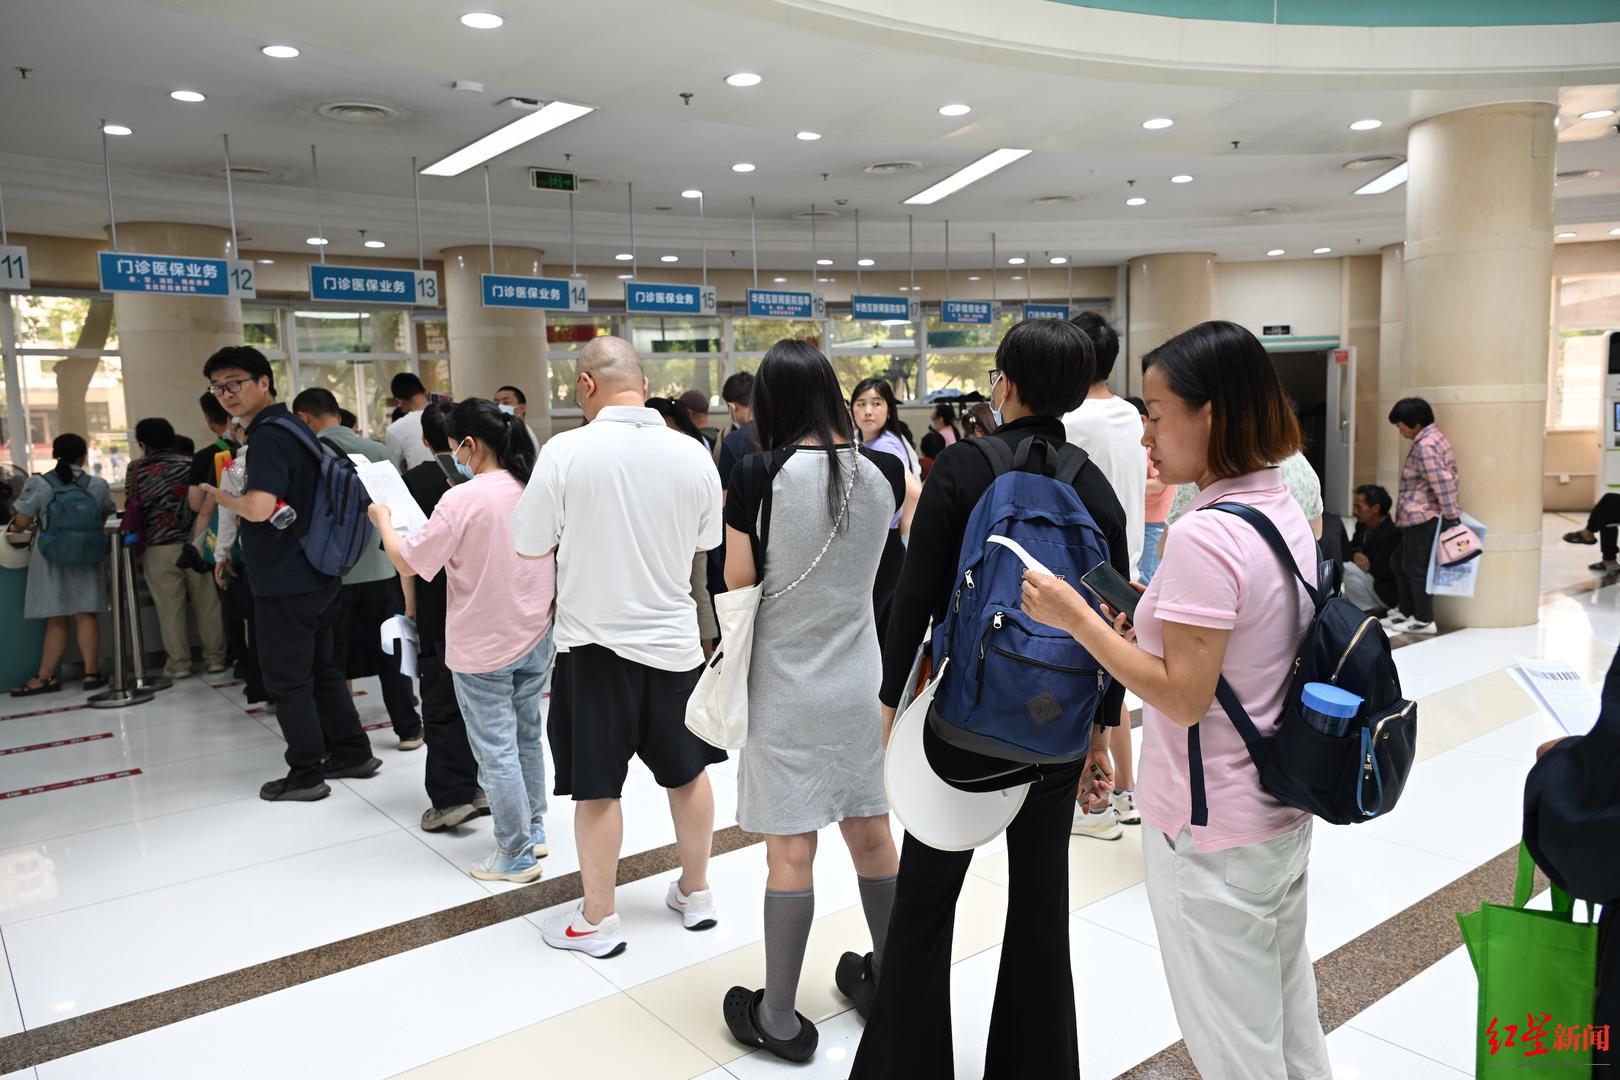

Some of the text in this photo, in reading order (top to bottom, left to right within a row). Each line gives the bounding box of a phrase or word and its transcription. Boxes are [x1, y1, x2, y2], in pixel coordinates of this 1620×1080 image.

[1, 255, 25, 279] 11
[117, 259, 218, 279] 门诊医保业务
[231, 269, 253, 290] 12
[323, 276, 406, 294] 门诊医保业务
[417, 276, 437, 298] 13
[491, 284, 561, 301] 门诊医保业务
[570, 286, 586, 304] 14
[635, 291, 694, 305] 门诊医保业务
[702, 291, 716, 309] 15
[813, 298, 825, 313] 16
